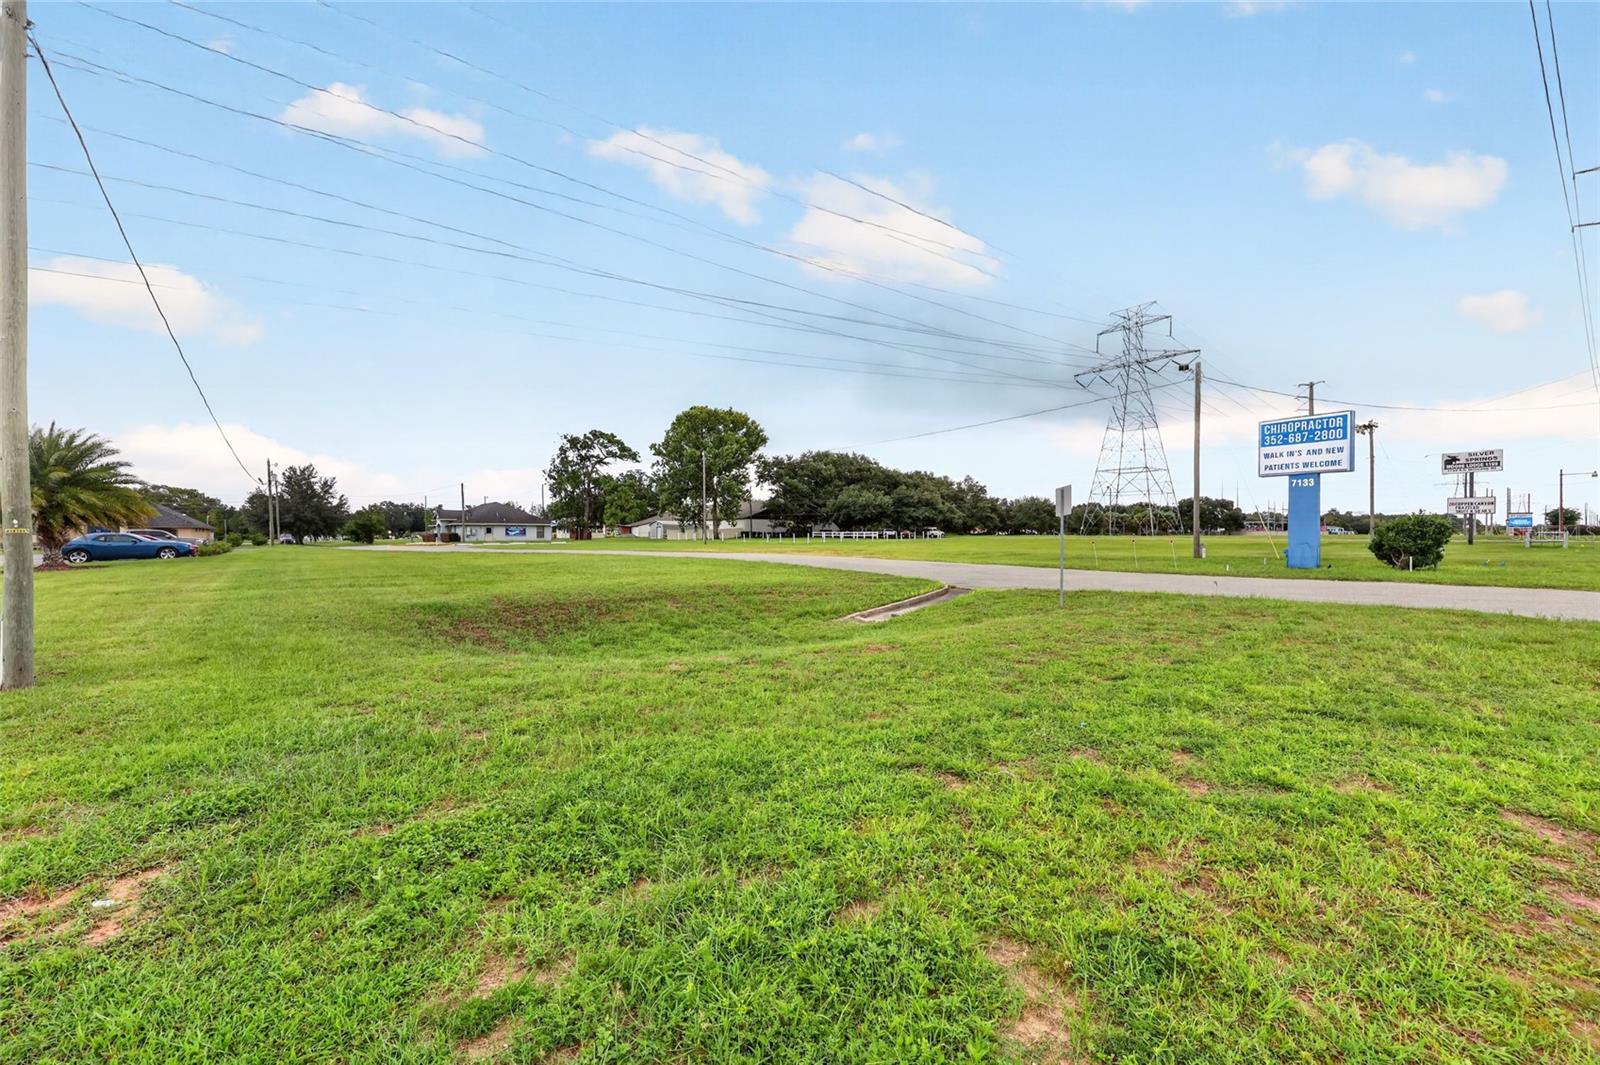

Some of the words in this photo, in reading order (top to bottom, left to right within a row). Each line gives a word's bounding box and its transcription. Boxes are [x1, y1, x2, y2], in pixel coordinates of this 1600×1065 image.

[1264, 417, 1343, 434] CHIROPRACTOR
[1264, 428, 1343, 445] 352-687-2800
[1306, 448, 1323, 456] AND
[1325, 446, 1344, 454] NEW
[1264, 462, 1300, 471] PATIENTS
[1302, 459, 1342, 468] WELCOME
[1291, 478, 1314, 486] 7133
